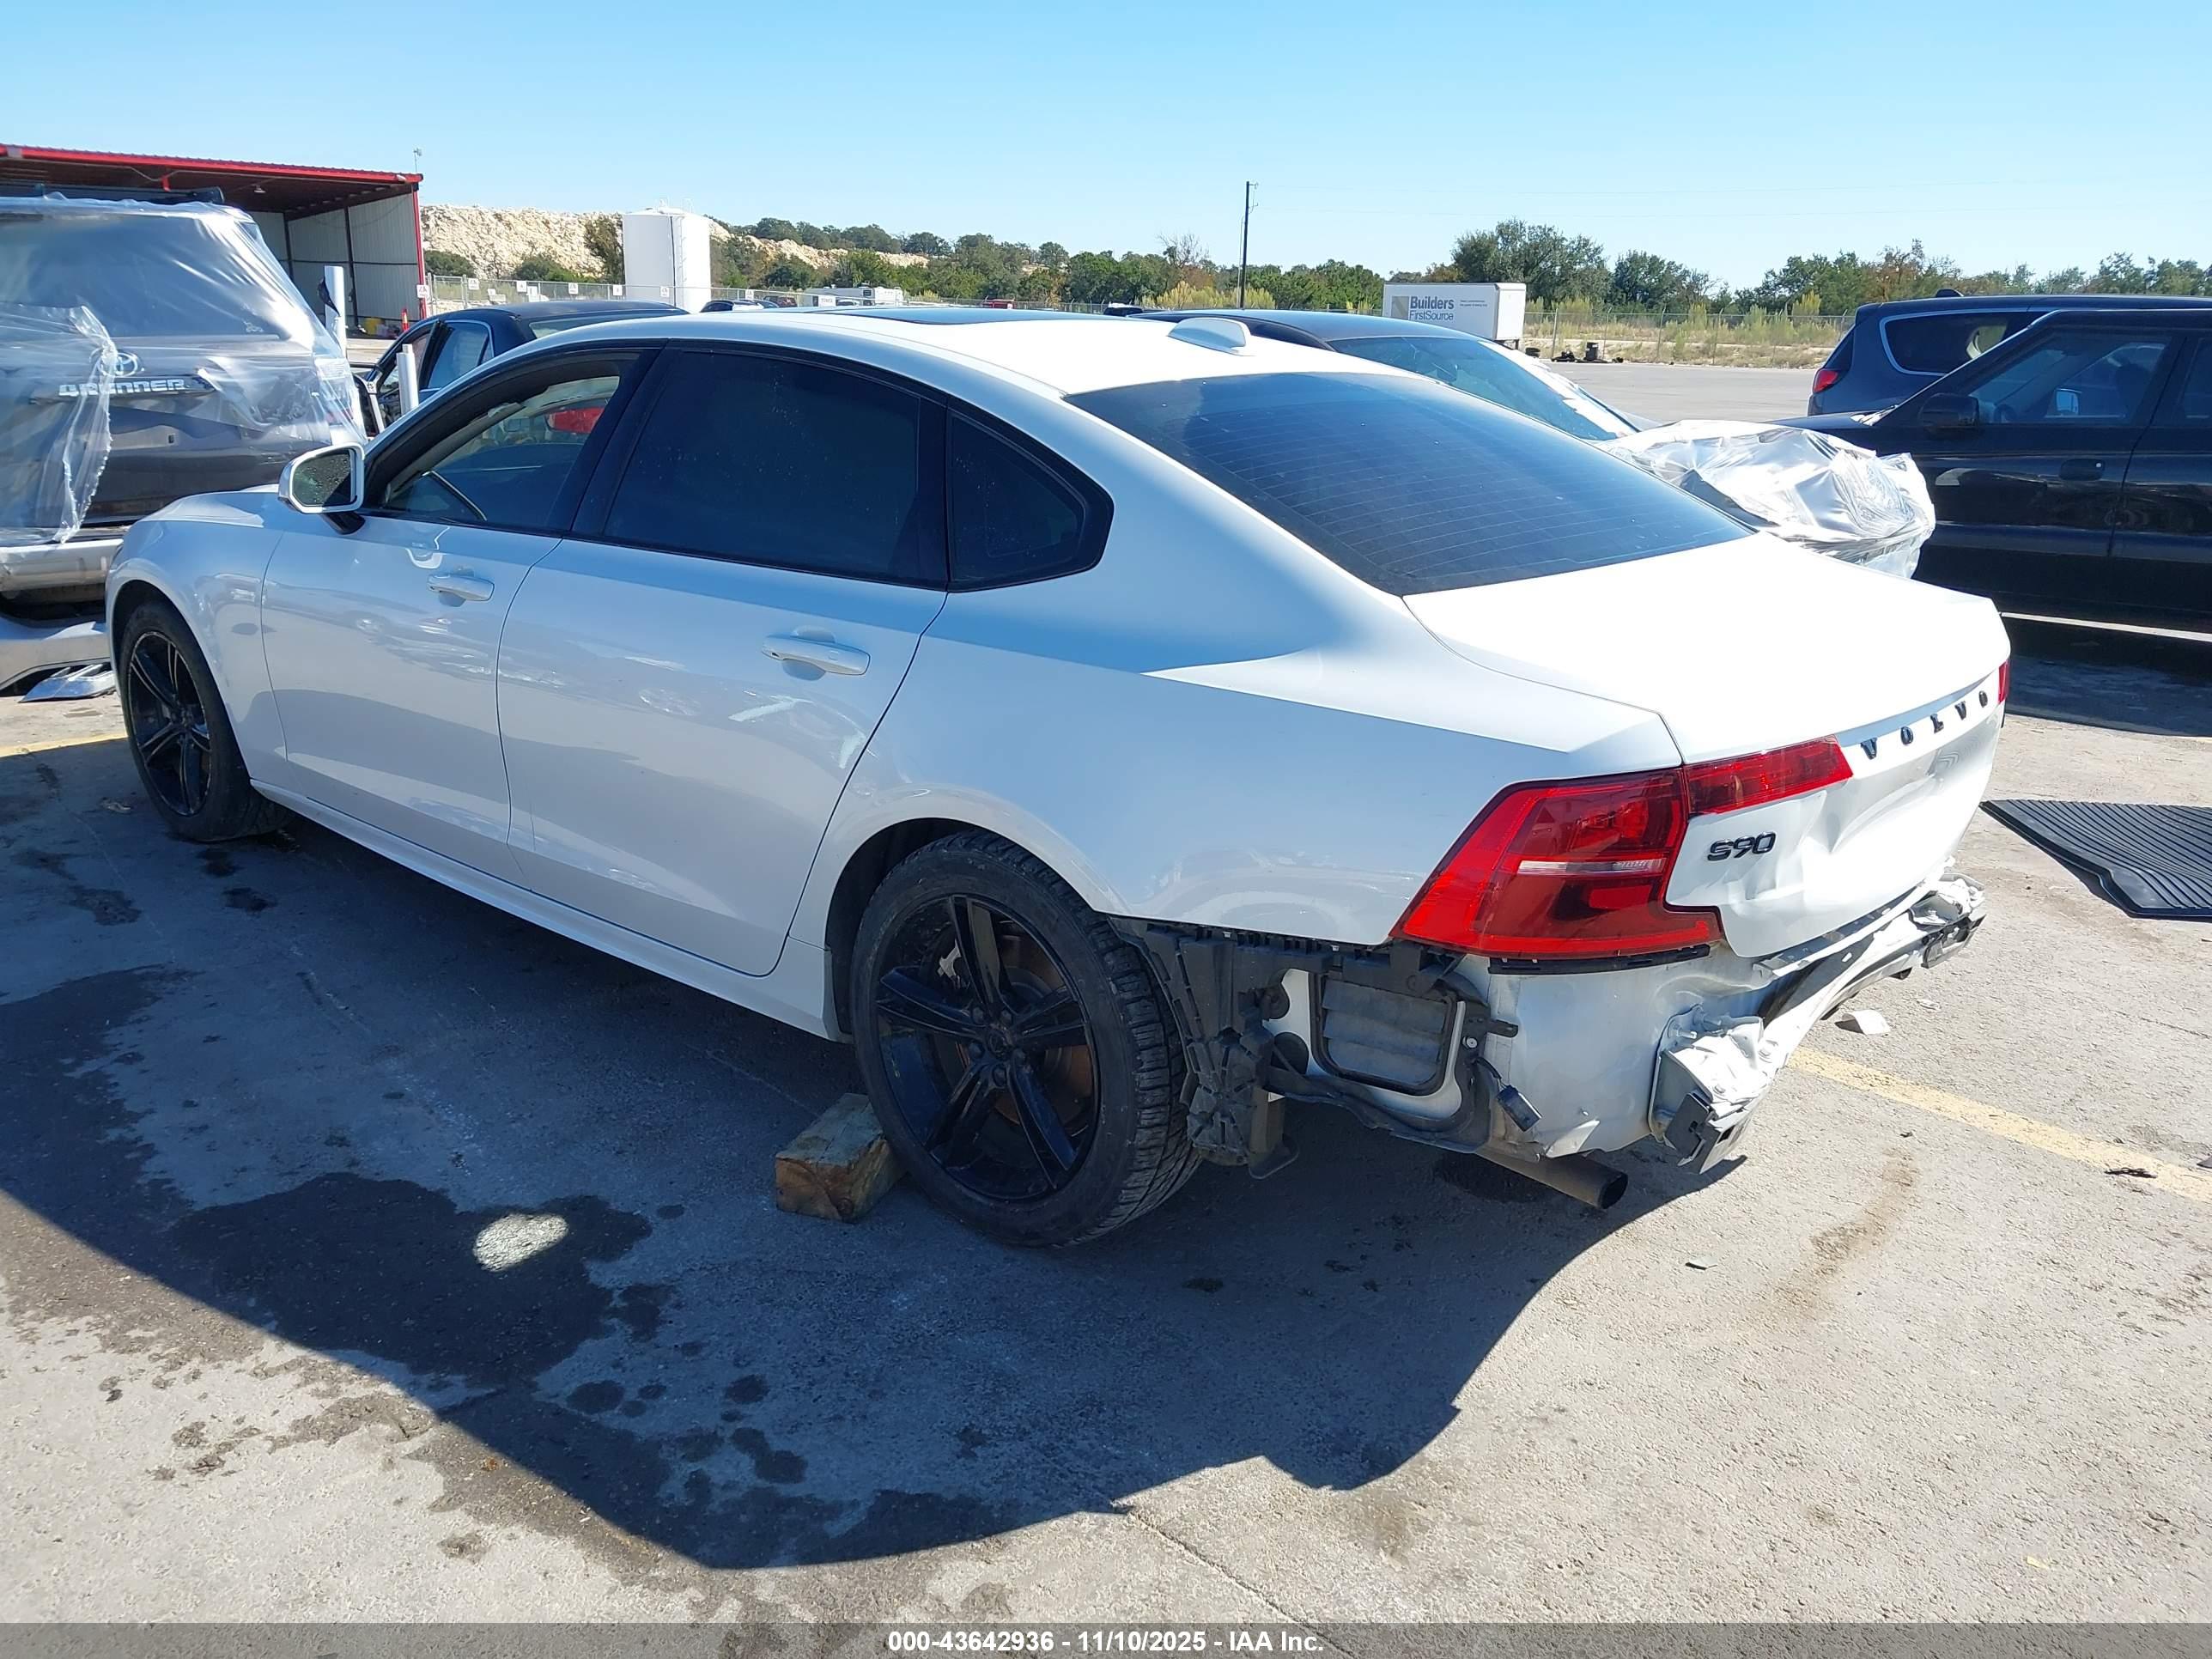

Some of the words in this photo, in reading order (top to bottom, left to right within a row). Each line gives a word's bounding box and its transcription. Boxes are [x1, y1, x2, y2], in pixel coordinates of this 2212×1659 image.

[1410, 296, 1455, 309] Builders
[1409, 310, 1454, 320] FirstSource
[1860, 690, 1988, 760] VOLVO
[1707, 831, 1777, 861] S90
